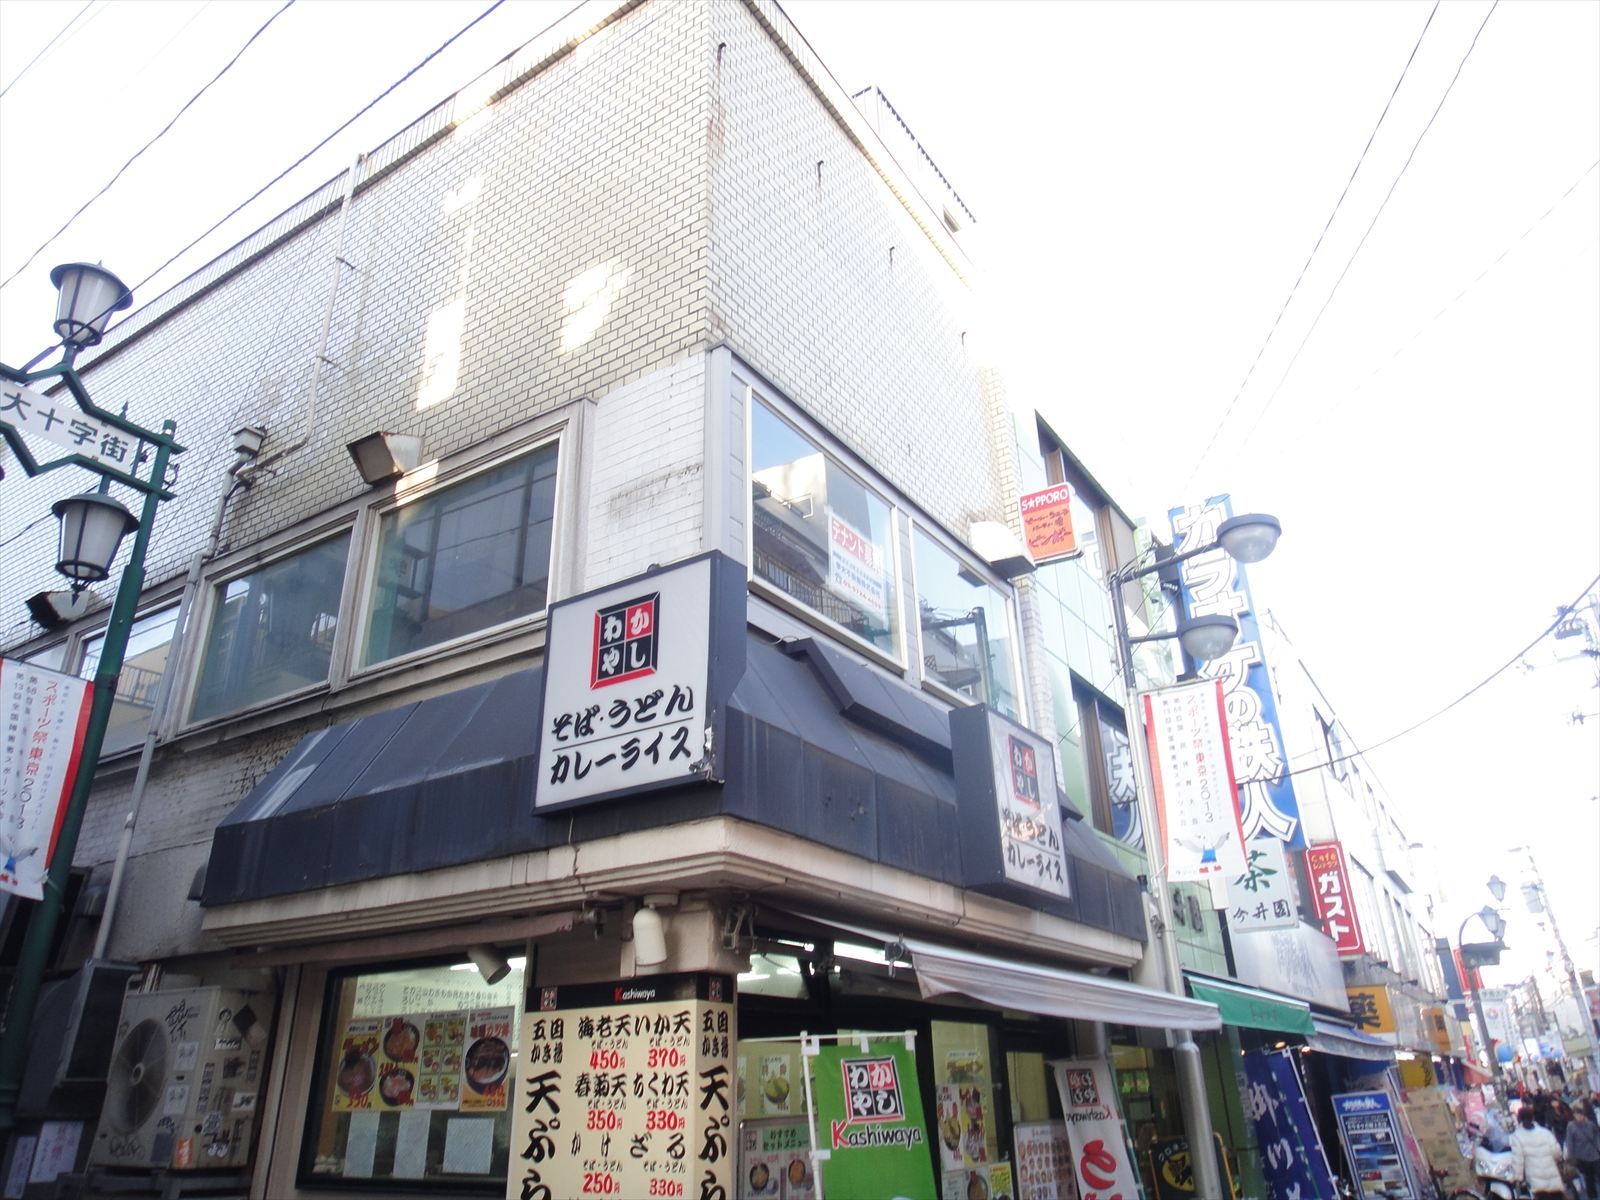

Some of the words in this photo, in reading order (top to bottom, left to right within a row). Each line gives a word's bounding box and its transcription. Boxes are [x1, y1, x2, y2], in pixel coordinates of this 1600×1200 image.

[0, 392, 129, 463] 大十字街
[550, 725, 692, 785] カレーライス
[1233, 849, 1279, 893] 茶
[1318, 870, 1350, 942] ガスト
[578, 1013, 631, 1040] 海老天
[635, 1010, 692, 1036] いか天
[632, 1070, 690, 1098] ちくわ天
[831, 1120, 922, 1151] Kashiwaya
